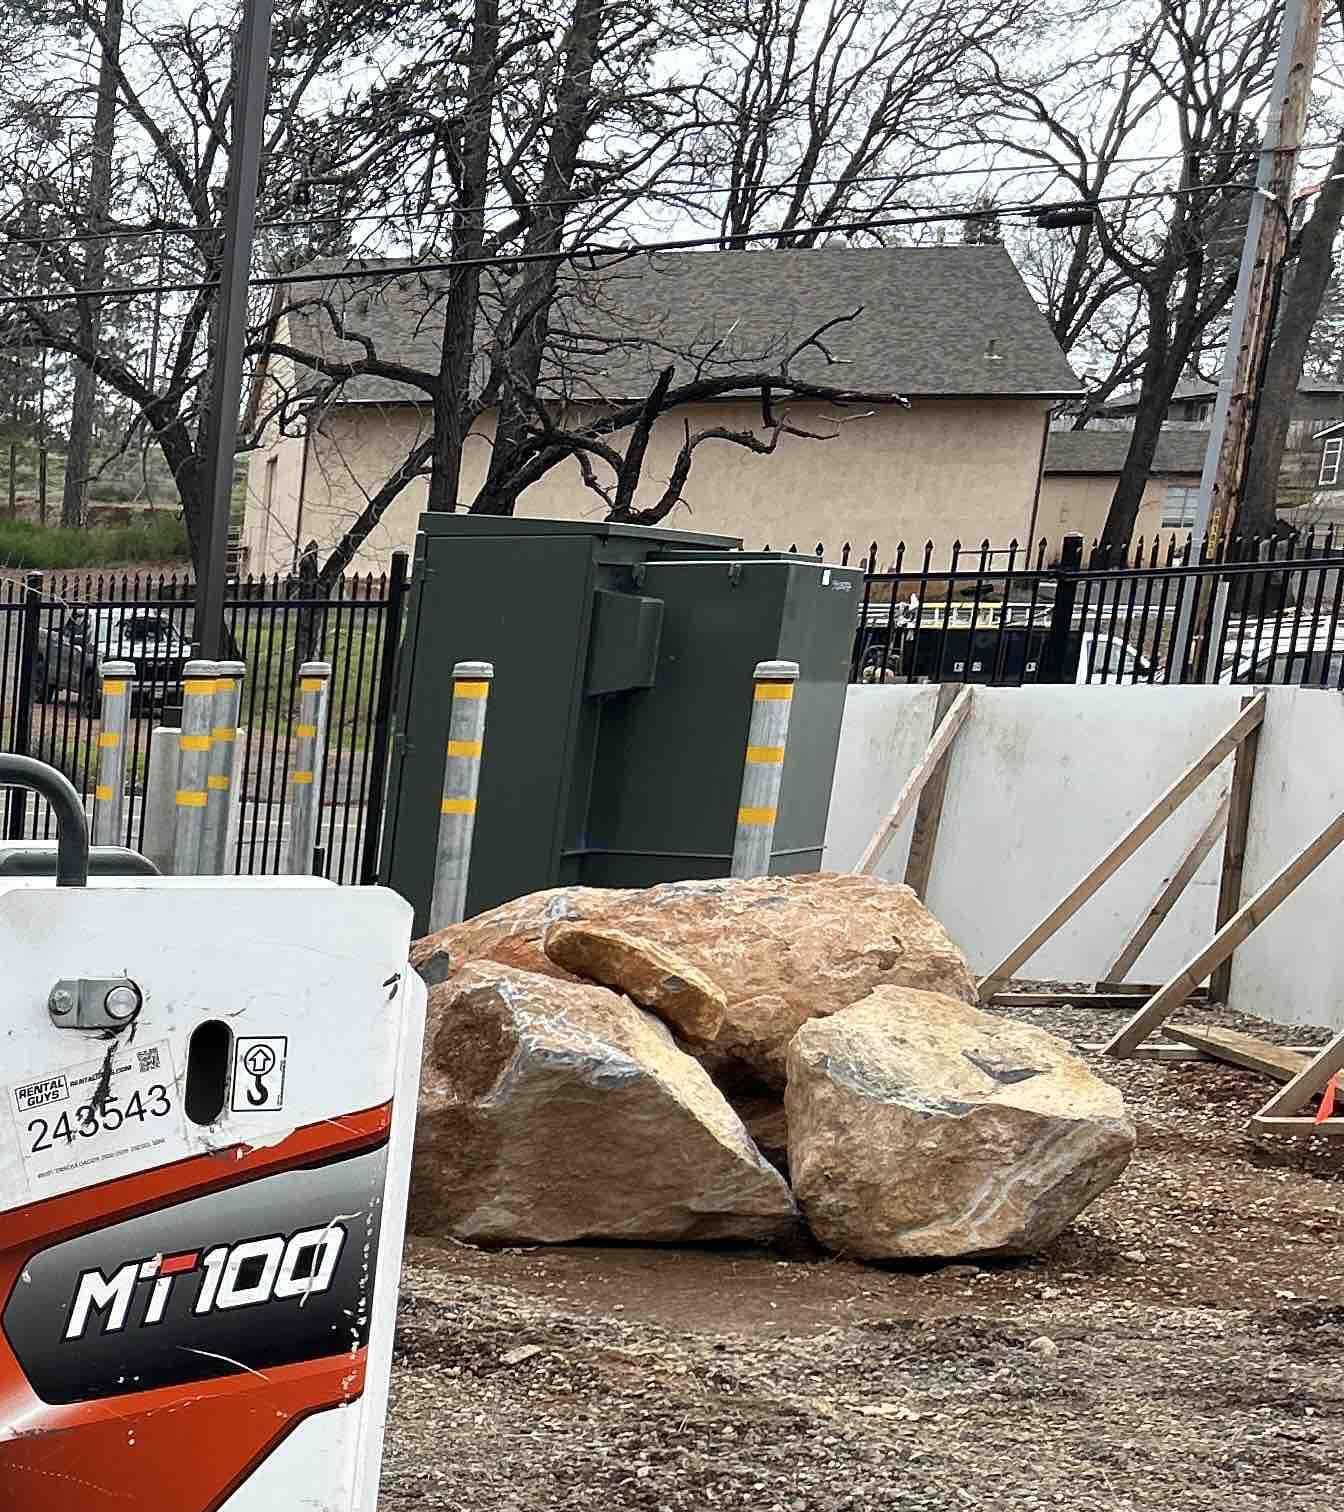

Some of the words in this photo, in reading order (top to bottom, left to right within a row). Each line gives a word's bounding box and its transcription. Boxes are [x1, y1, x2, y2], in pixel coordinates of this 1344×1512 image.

[18, 1079, 64, 1100] RENTAL
[27, 1090, 60, 1107] GUYS
[27, 1085, 171, 1152] 243543
